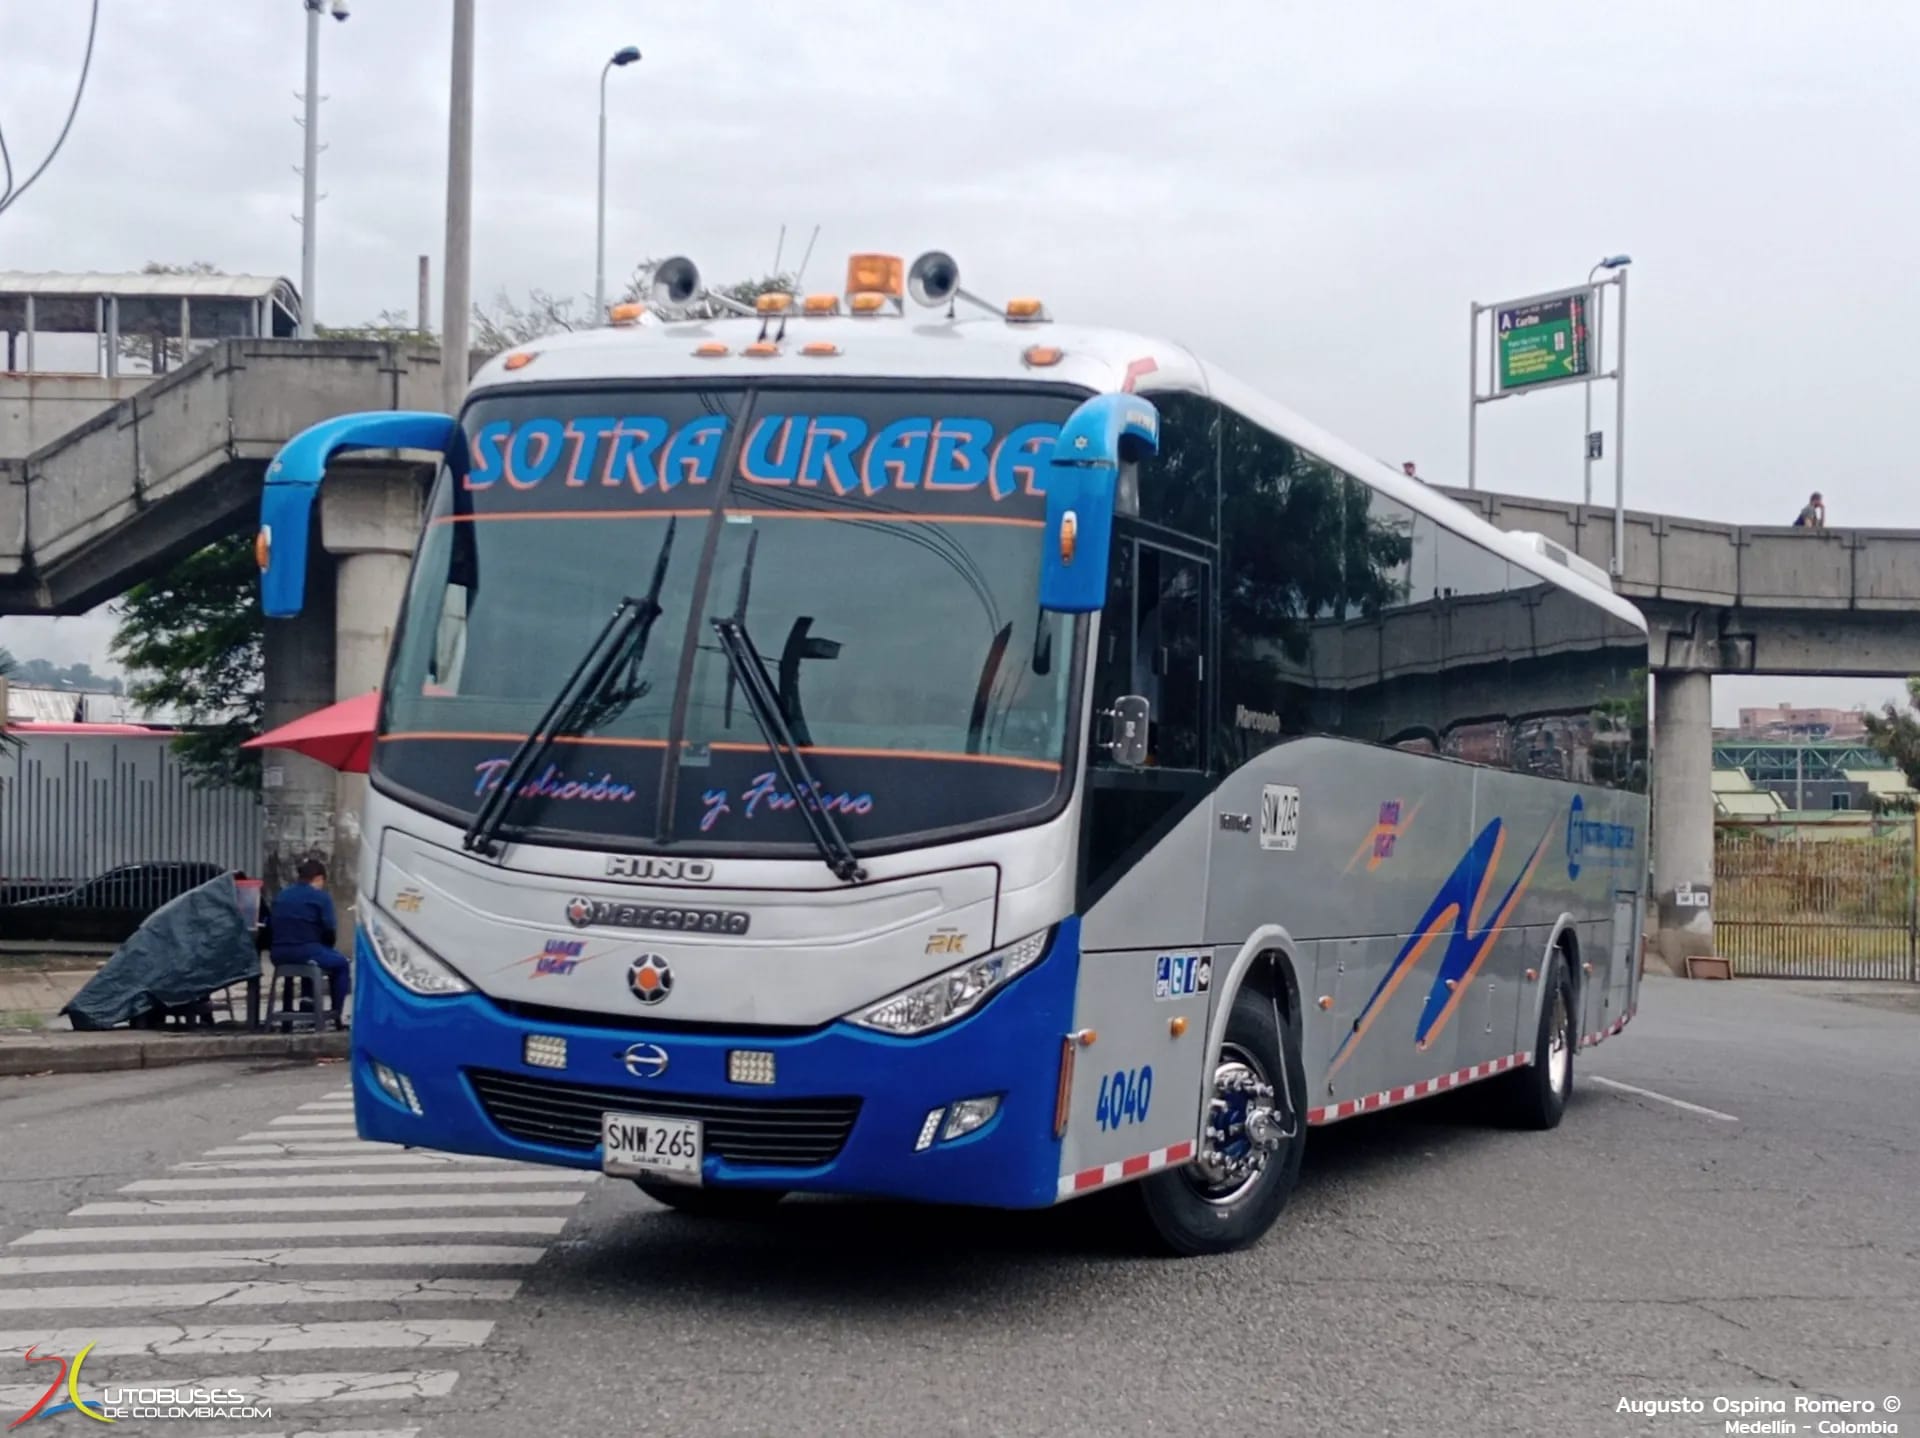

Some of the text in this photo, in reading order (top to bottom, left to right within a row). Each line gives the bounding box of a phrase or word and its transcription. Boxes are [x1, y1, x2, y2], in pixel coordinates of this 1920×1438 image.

[463, 414, 1060, 501] SOTRA URABA
[702, 787, 731, 832] y
[606, 856, 715, 882] HINO
[598, 902, 747, 931] Marcopolo
[1096, 1064, 1153, 1132] 4040
